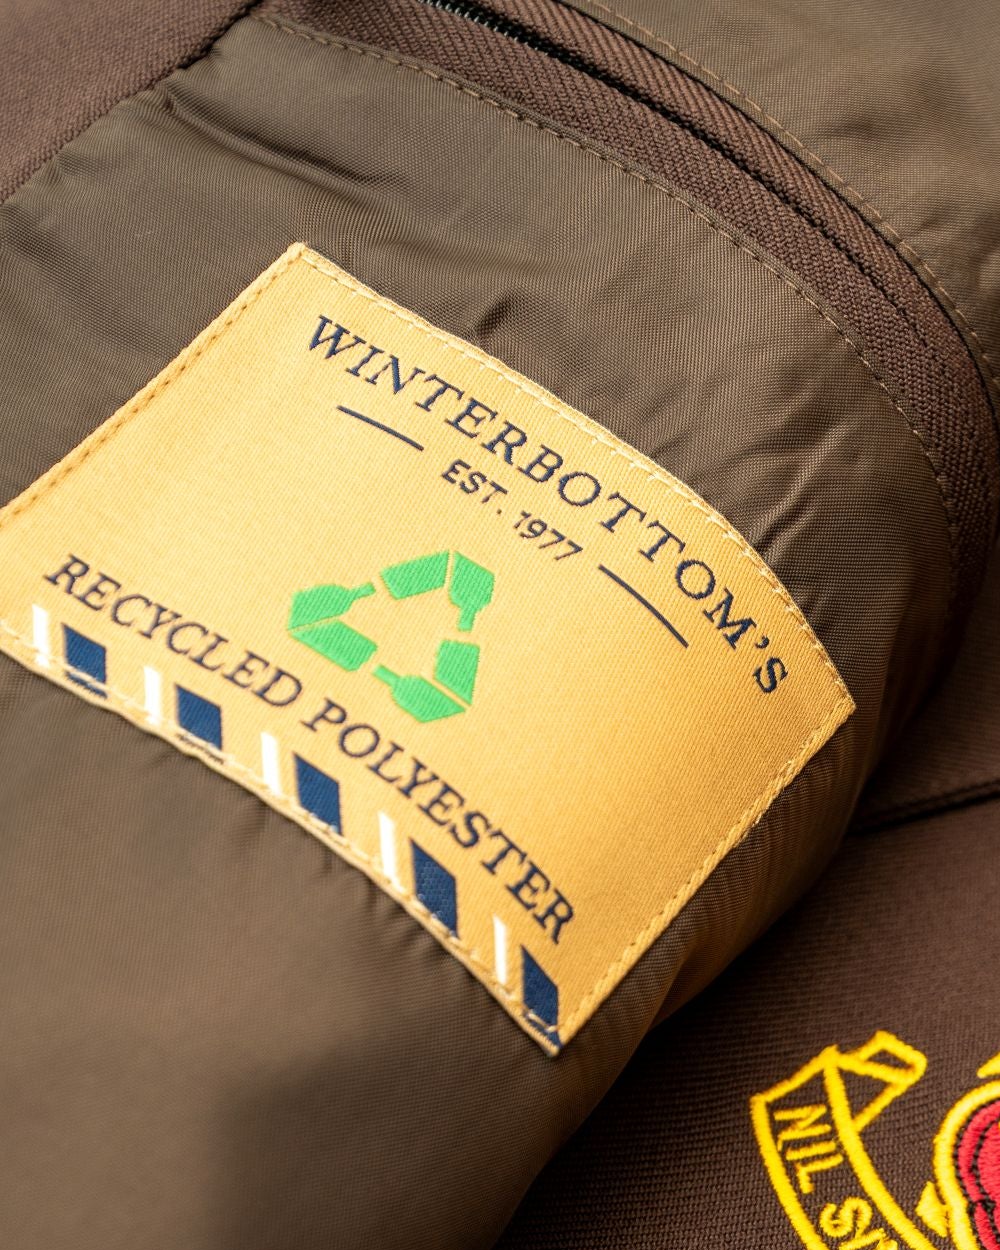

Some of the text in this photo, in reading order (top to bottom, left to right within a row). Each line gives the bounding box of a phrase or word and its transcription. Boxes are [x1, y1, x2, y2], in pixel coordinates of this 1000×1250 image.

[308, 315, 789, 696] WINTERBOTTOM'S
[442, 459, 583, 561] EST. 1977
[44, 555, 576, 945] RECYCLED POLYESTER
[773, 1104, 846, 1193] NIL
